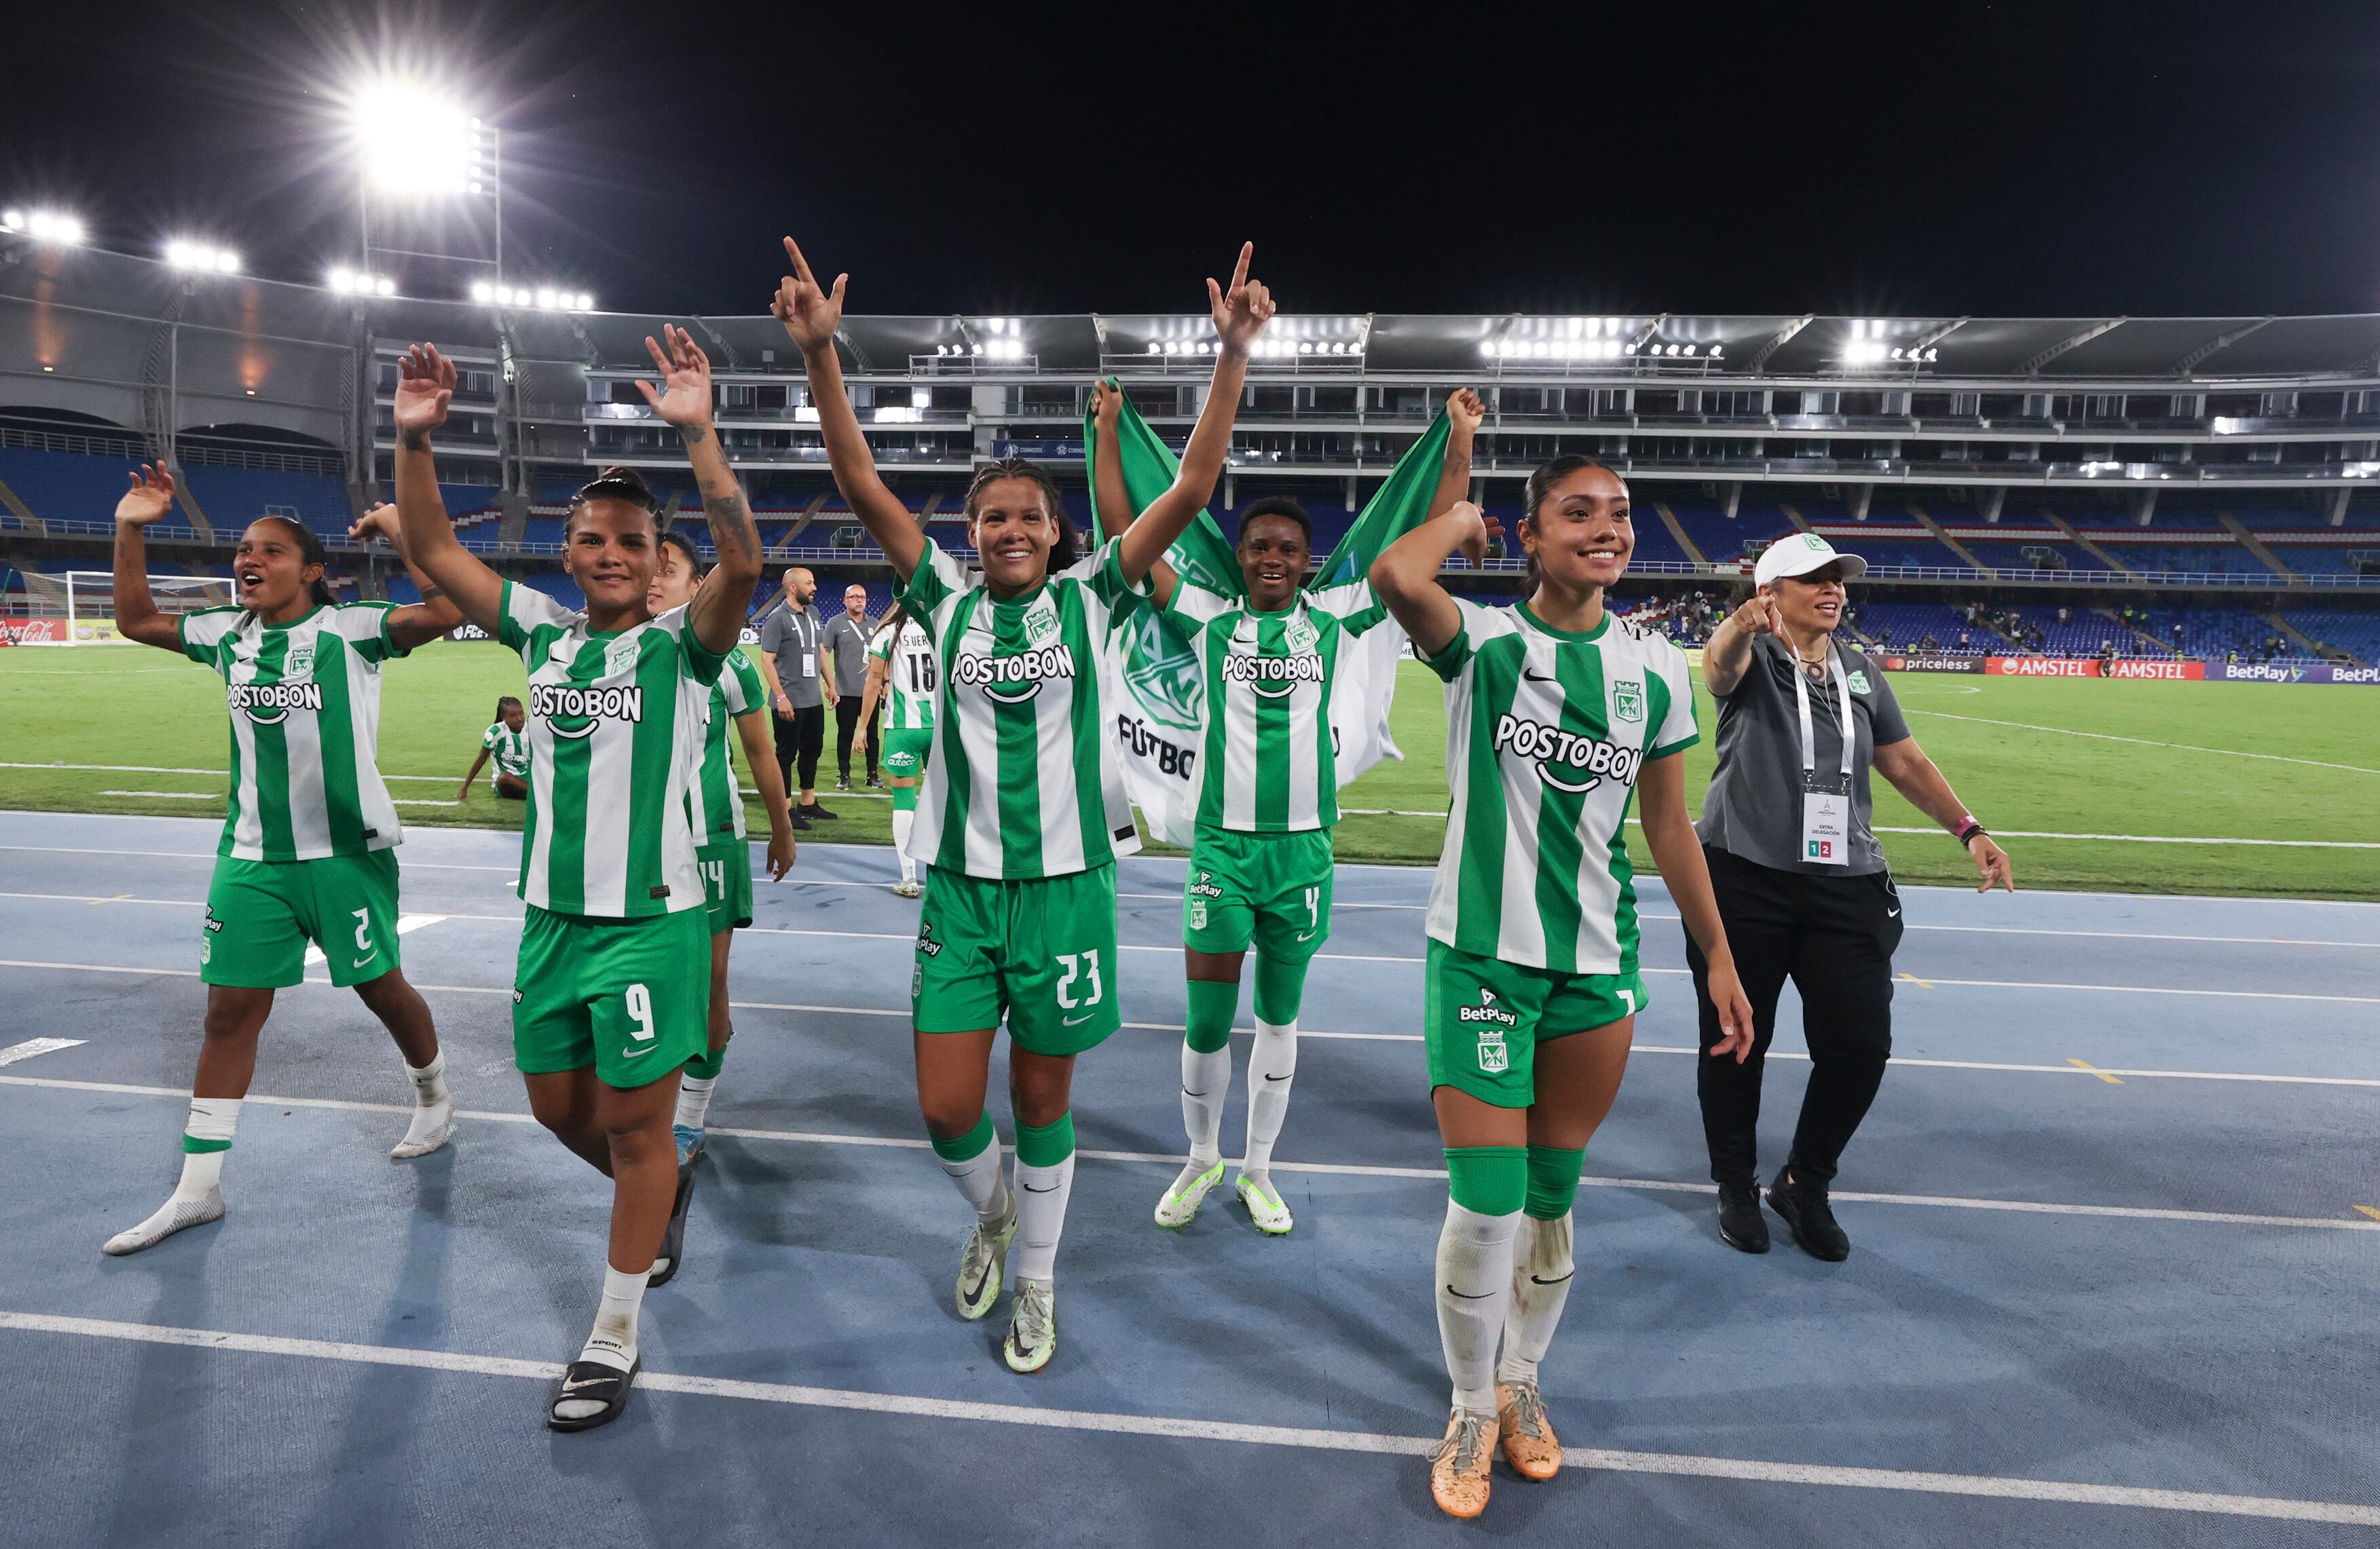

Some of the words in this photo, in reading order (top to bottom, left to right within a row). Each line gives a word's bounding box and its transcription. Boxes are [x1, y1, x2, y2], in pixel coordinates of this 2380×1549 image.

[907, 654, 935, 692] 18
[1221, 654, 1324, 682] POSTOBON
[1906, 657, 1971, 671] priceless
[2020, 660, 2086, 676] AMSTEL
[2117, 662, 2184, 679] AMSTEL
[2226, 665, 2289, 682] BetPlay
[1494, 713, 1643, 788] POSTOBON
[1811, 844, 1817, 853] 1
[1822, 845, 1829, 854] 2
[1189, 884, 1222, 897] BetPlay
[1305, 887, 1320, 928] 4
[351, 907, 372, 951] 2
[1055, 948, 1102, 1009] 23
[625, 983, 655, 1041] 9
[1616, 989, 1636, 1017] 7
[1460, 1007, 1515, 1026] BetPlay
[592, 1340, 623, 1350] SPORT
